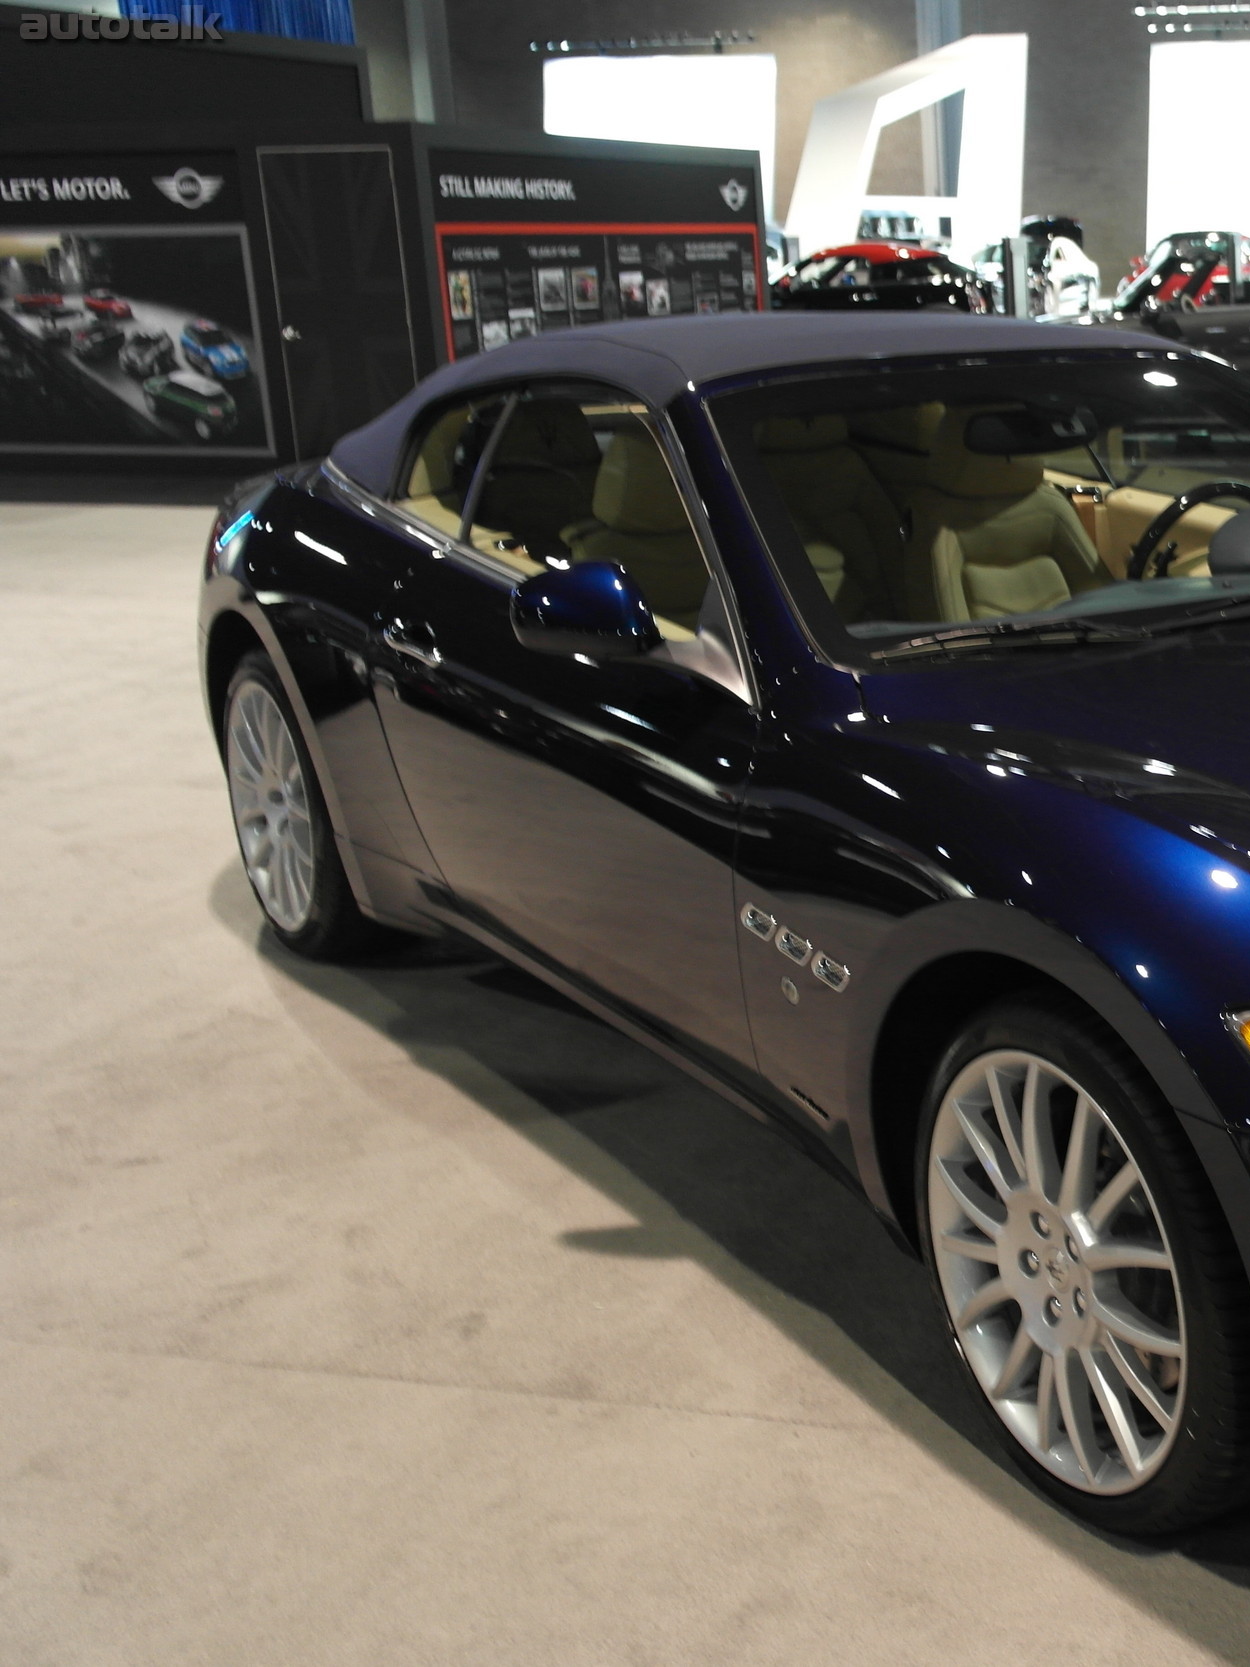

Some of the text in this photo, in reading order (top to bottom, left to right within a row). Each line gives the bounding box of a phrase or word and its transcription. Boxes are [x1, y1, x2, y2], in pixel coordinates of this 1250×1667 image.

[0, 176, 131, 201] LET'S MOTOR.
[439, 174, 576, 200] STILL MAKING HISTORY.
